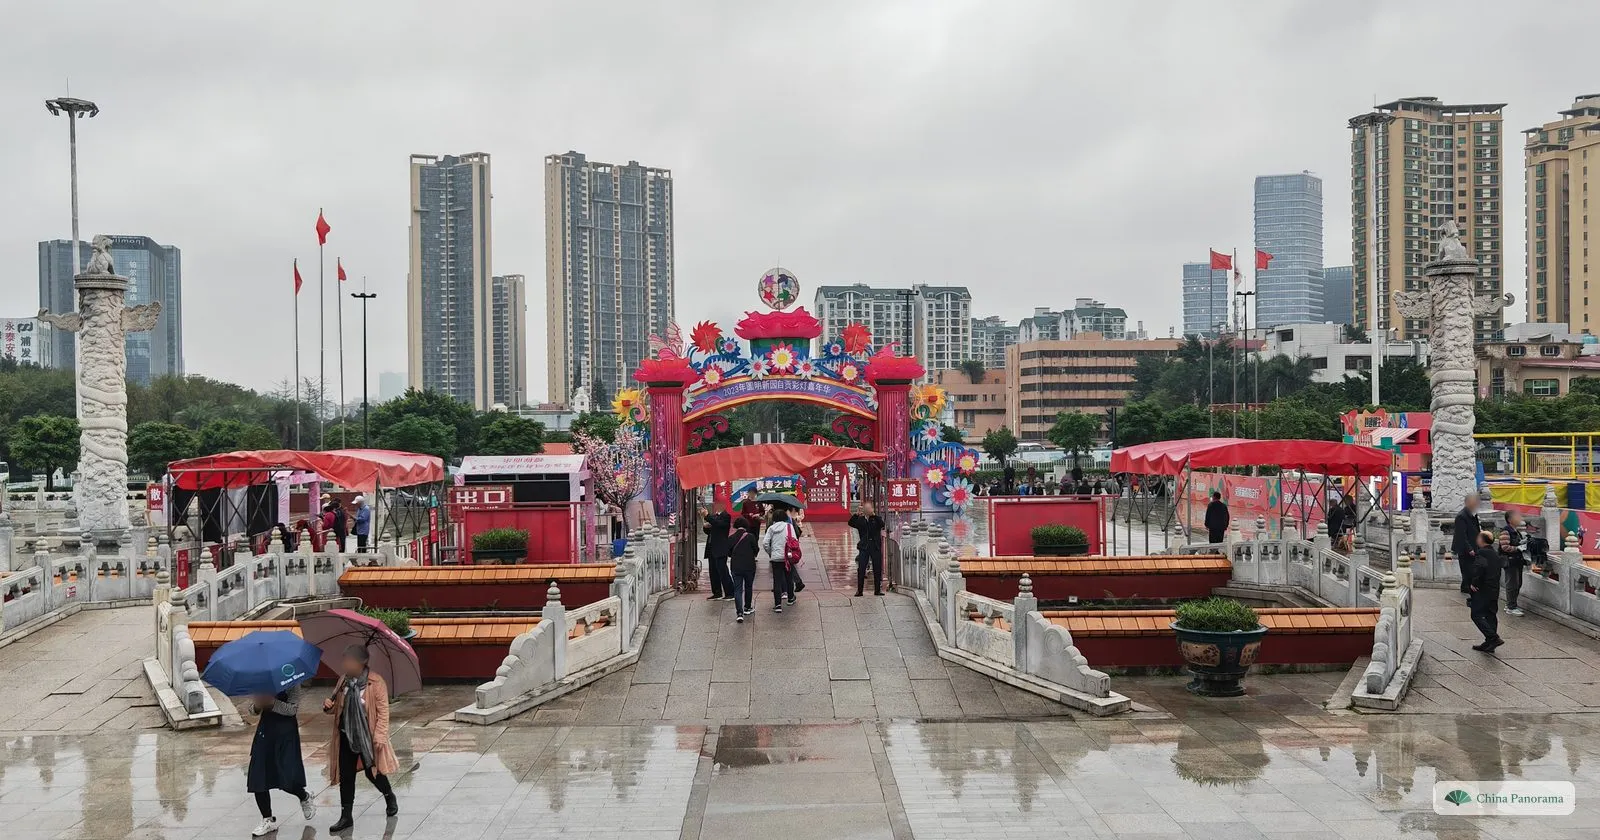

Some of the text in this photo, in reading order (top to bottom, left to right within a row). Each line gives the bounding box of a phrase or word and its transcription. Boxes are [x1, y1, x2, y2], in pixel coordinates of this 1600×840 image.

[150, 488, 161, 501] 散
[456, 490, 506, 504] 出口
[881, 483, 918, 497] 通道
